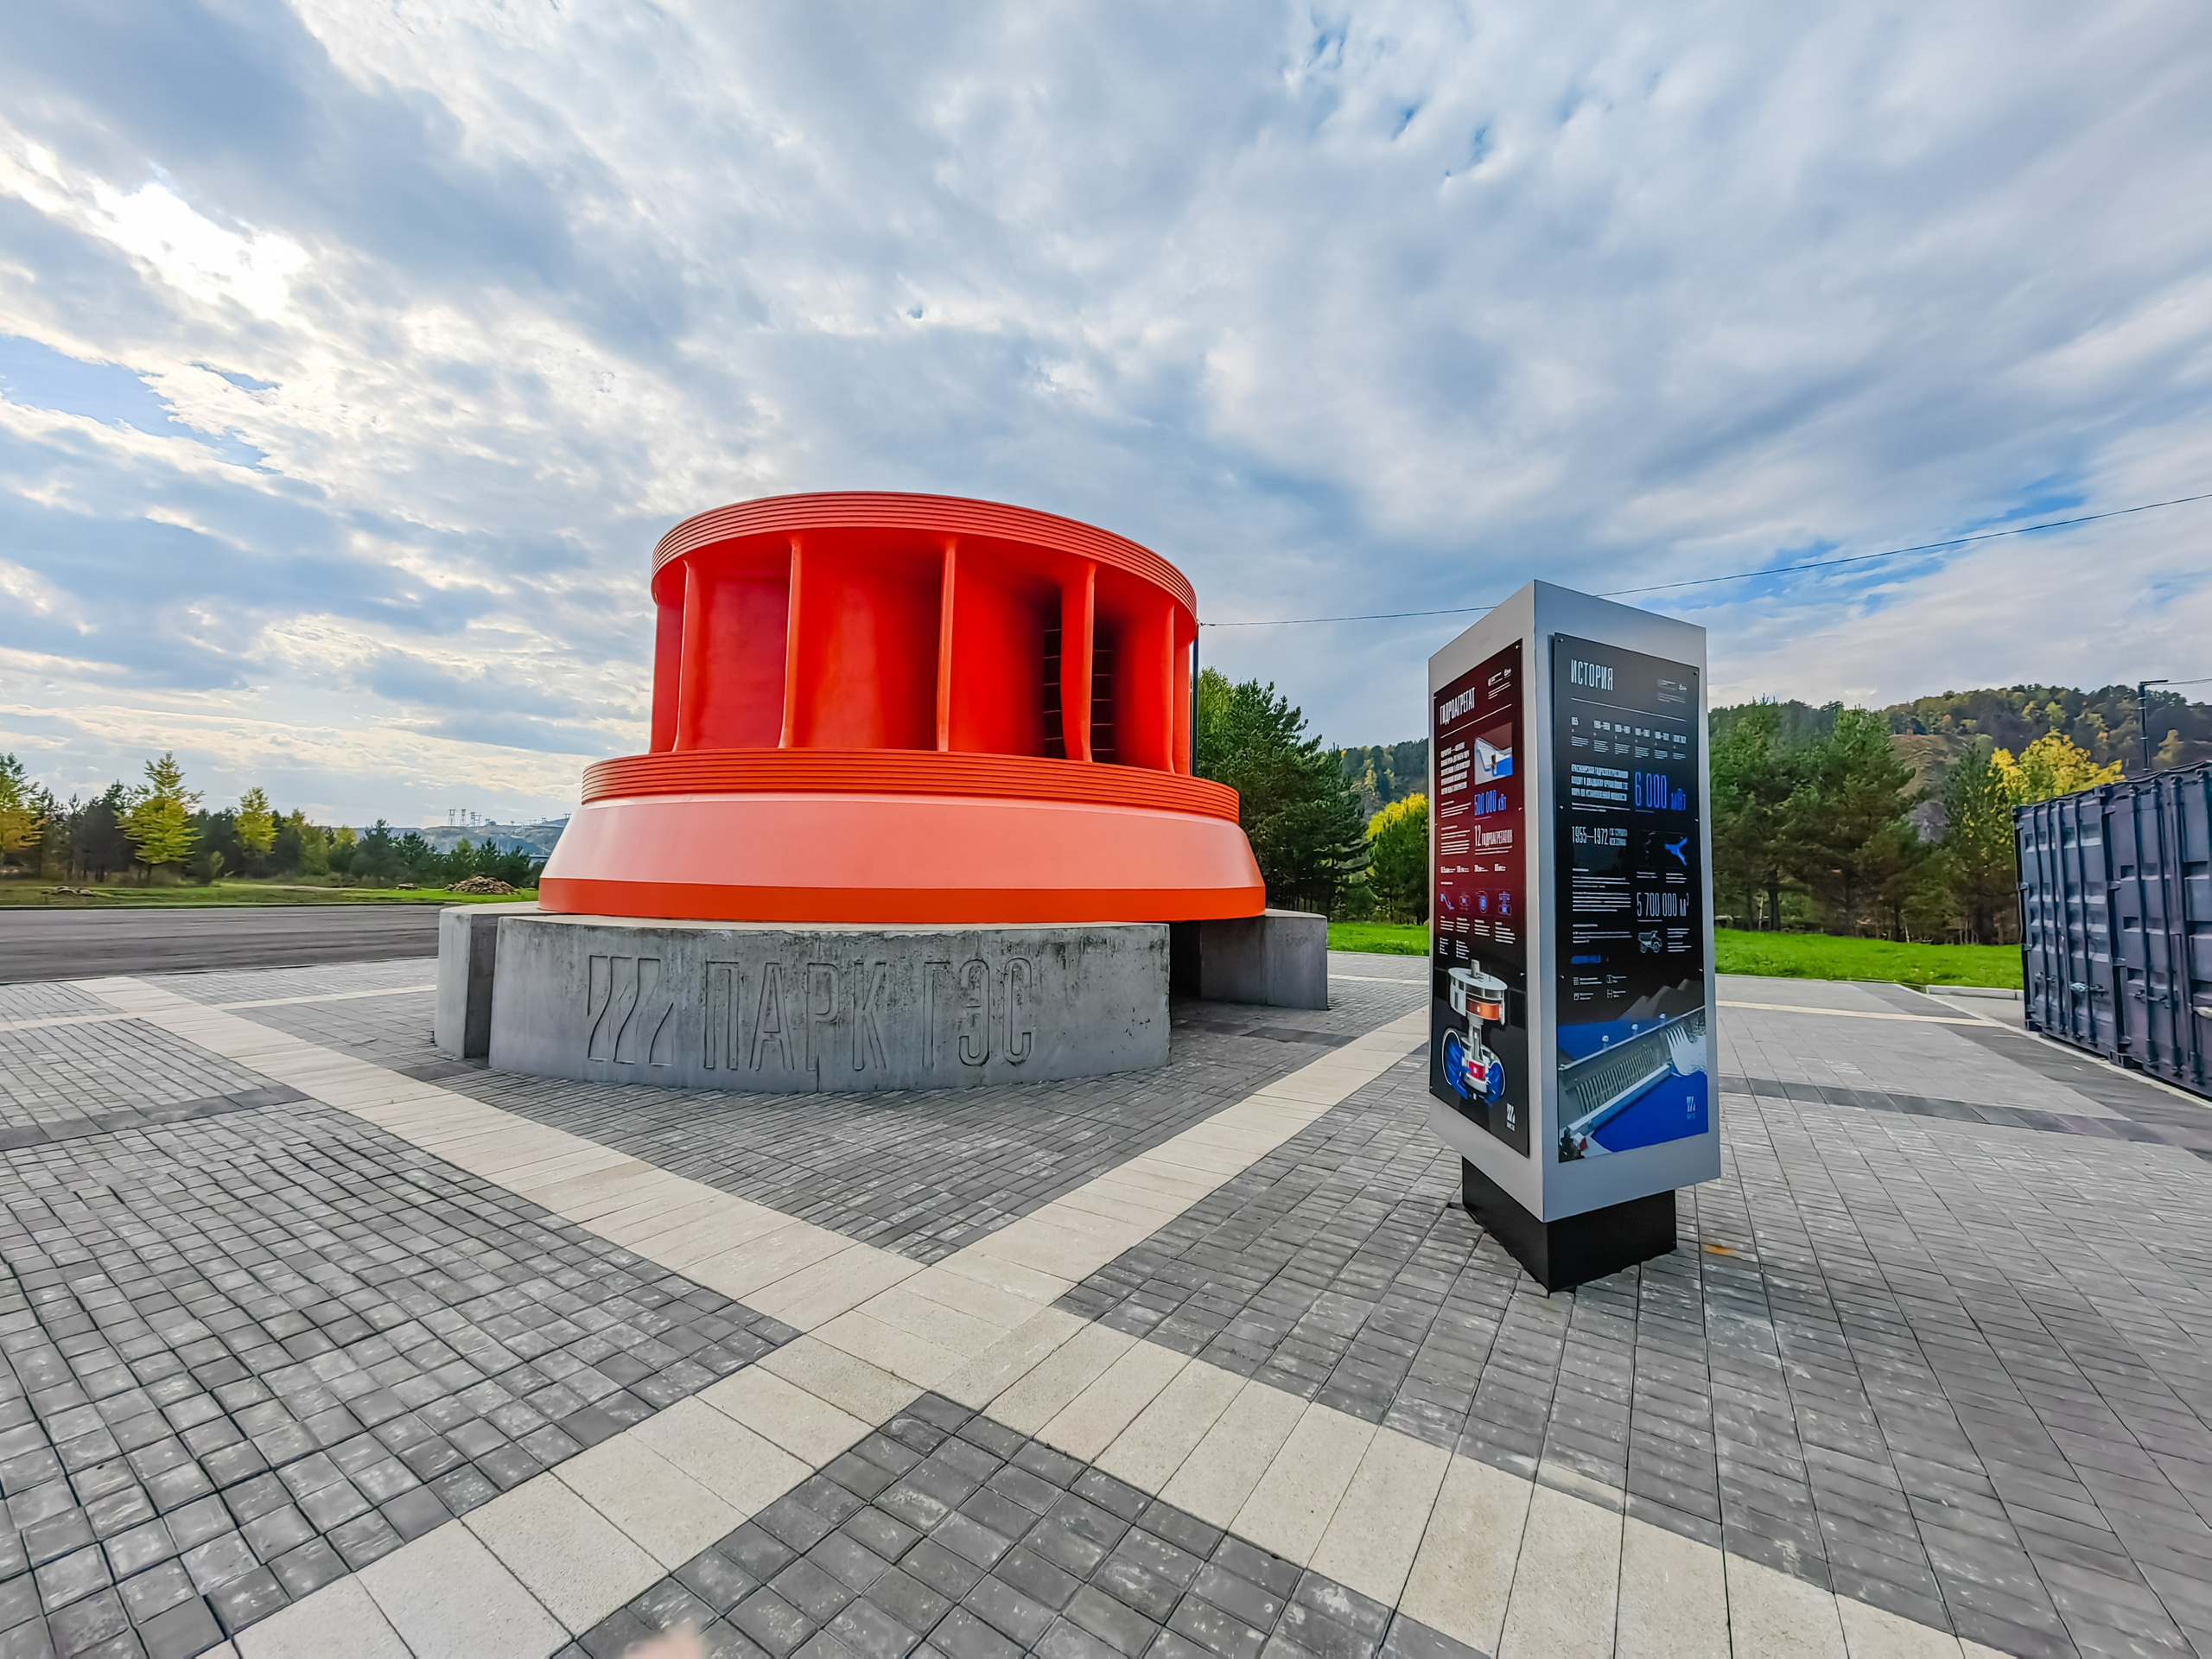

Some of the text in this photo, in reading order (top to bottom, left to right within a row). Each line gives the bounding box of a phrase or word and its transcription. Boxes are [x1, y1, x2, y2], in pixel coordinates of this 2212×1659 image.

[1571, 658, 1613, 691] ИСТОРИЯ
[1440, 687, 1475, 726] ГИДРОАГРЕГАТ
[1635, 772, 1642, 806] 6
[1646, 772, 1667, 809] 000
[1474, 824, 1481, 847] 12
[1637, 892, 1642, 917] 5
[1643, 892, 1660, 917] 700
[1662, 893, 1677, 917] 000
[703, 957, 1033, 1071] ПАРК ГЭС
